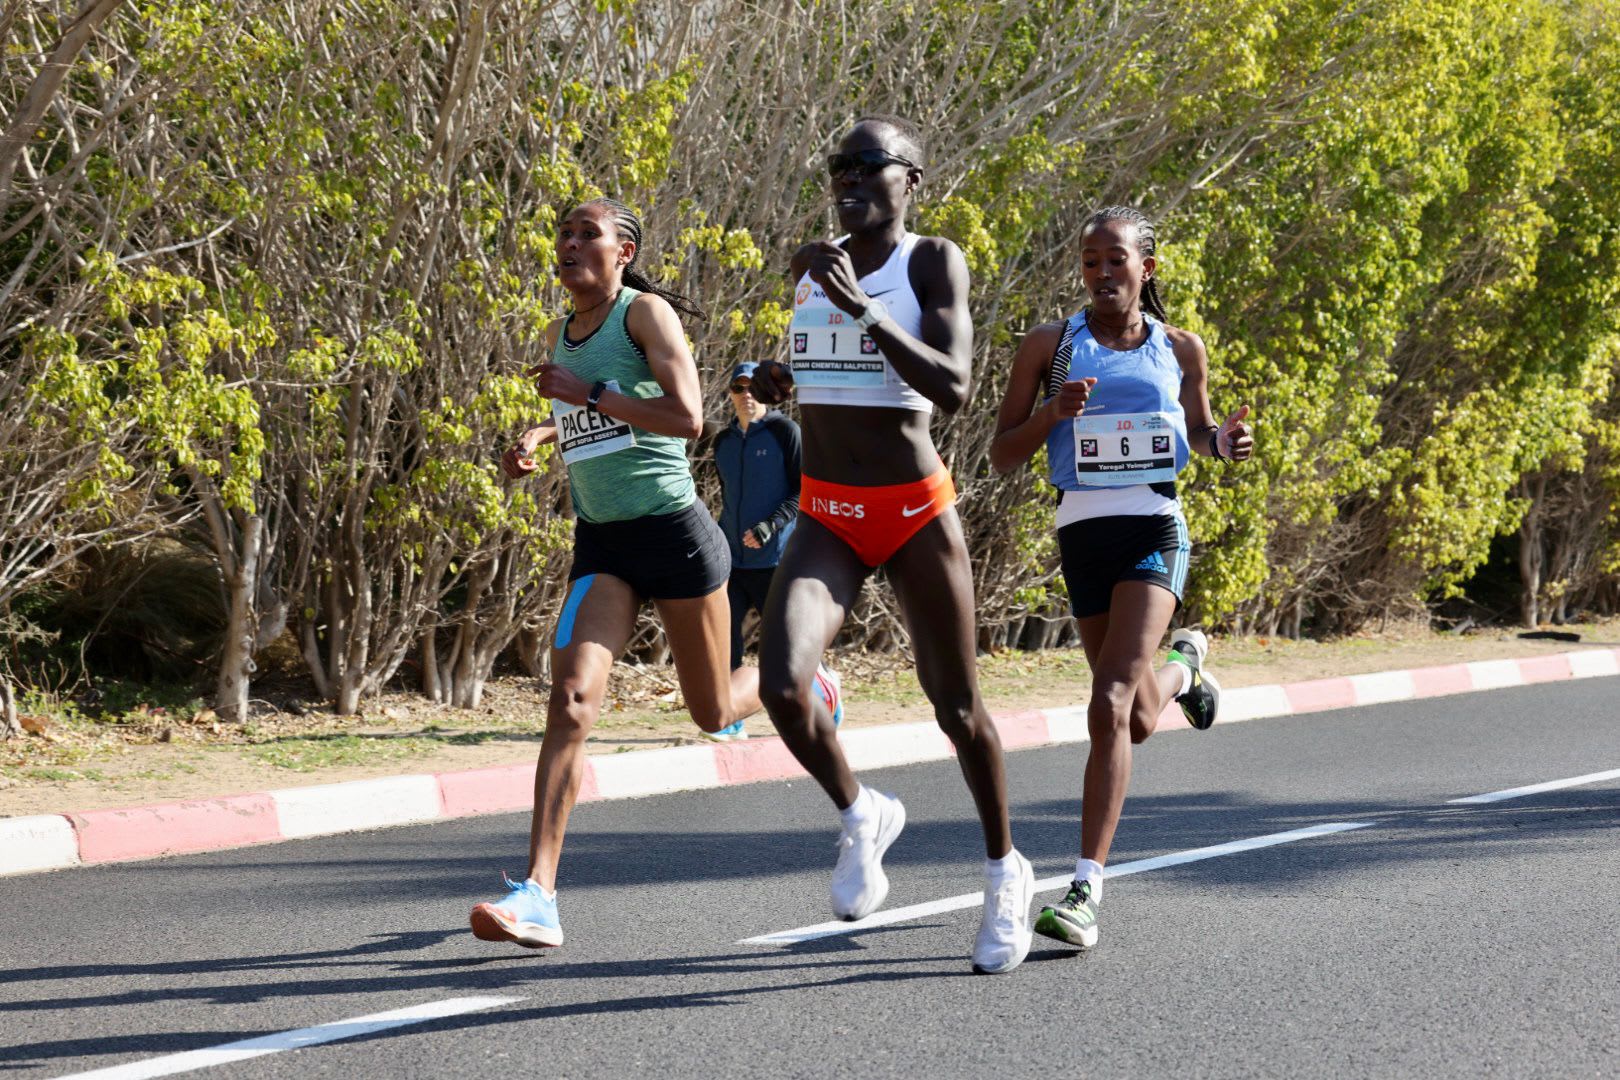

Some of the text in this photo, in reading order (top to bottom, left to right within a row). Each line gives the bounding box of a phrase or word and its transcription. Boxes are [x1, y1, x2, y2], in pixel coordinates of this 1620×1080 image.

[831, 332, 837, 354] 1
[843, 362, 882, 370] SALPETER
[1120, 436, 1130, 456] 6
[812, 496, 865, 519] INEOS
[1135, 563, 1168, 574] adidas
